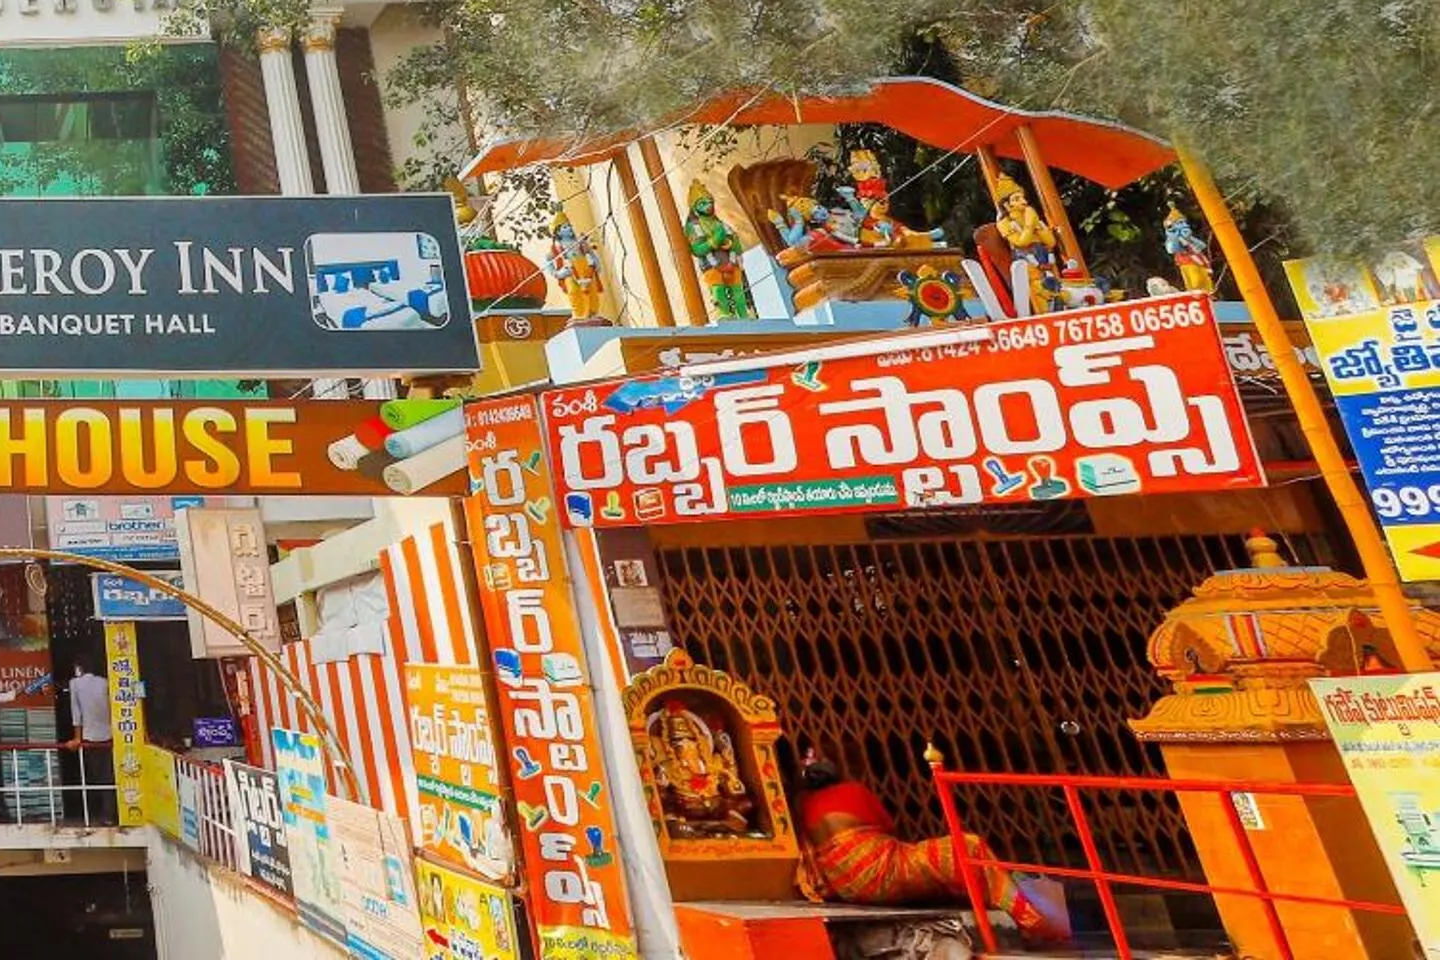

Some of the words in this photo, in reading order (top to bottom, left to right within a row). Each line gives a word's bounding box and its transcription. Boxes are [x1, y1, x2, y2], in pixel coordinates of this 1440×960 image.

[173, 240, 296, 295] INN
[144, 313, 216, 335] HALL
[1054, 315, 1125, 343] 76758
[1129, 301, 1206, 333] 06566
[1329, 340, 1440, 388] జ్యోతి
[559, 384, 798, 516] రబ్బర్
[819, 336, 1241, 508] స్టాంప్స్
[109, 521, 162, 532] brother
[0, 667, 46, 679] LINEN
